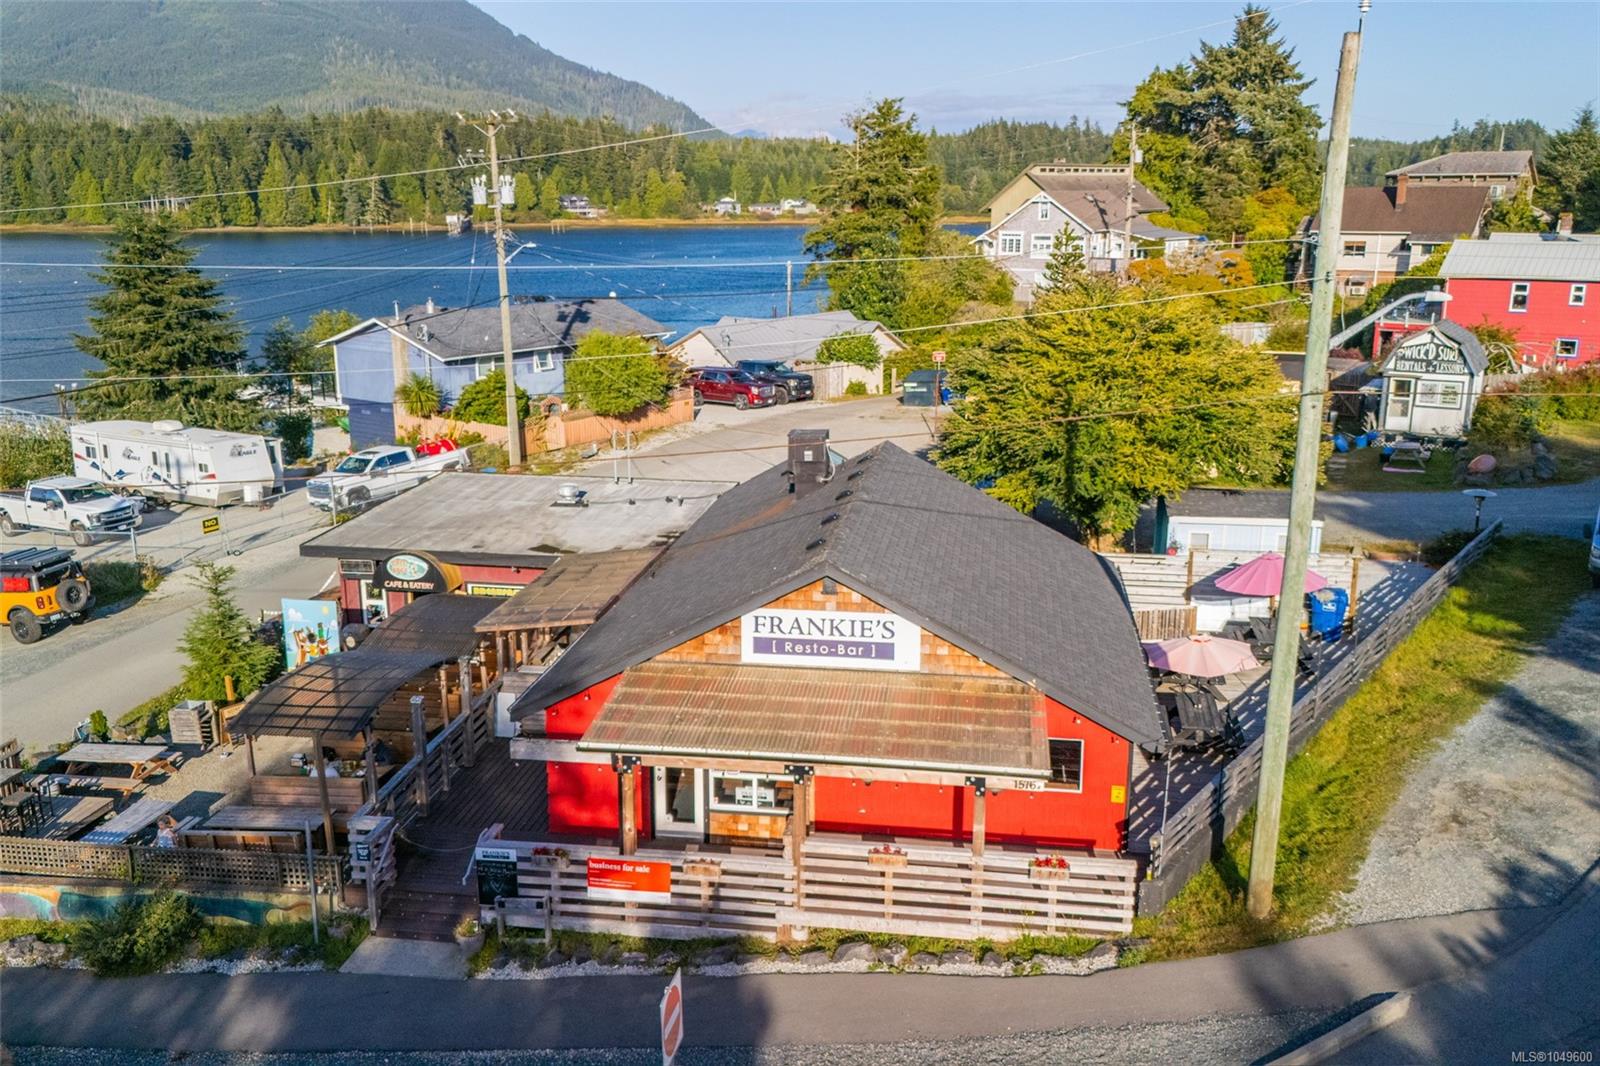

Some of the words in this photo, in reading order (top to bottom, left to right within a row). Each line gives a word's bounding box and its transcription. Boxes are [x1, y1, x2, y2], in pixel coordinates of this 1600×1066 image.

[1396, 360, 1426, 371] RENTALS
[384, 580, 402, 588] CAFE
[410, 581, 435, 590] EATERY
[753, 615, 895, 639] FRANKIE'S
[784, 642, 864, 656] Resto-Bar
[589, 861, 621, 871] business
[623, 864, 634, 872] for
[635, 865, 650, 873] sale
